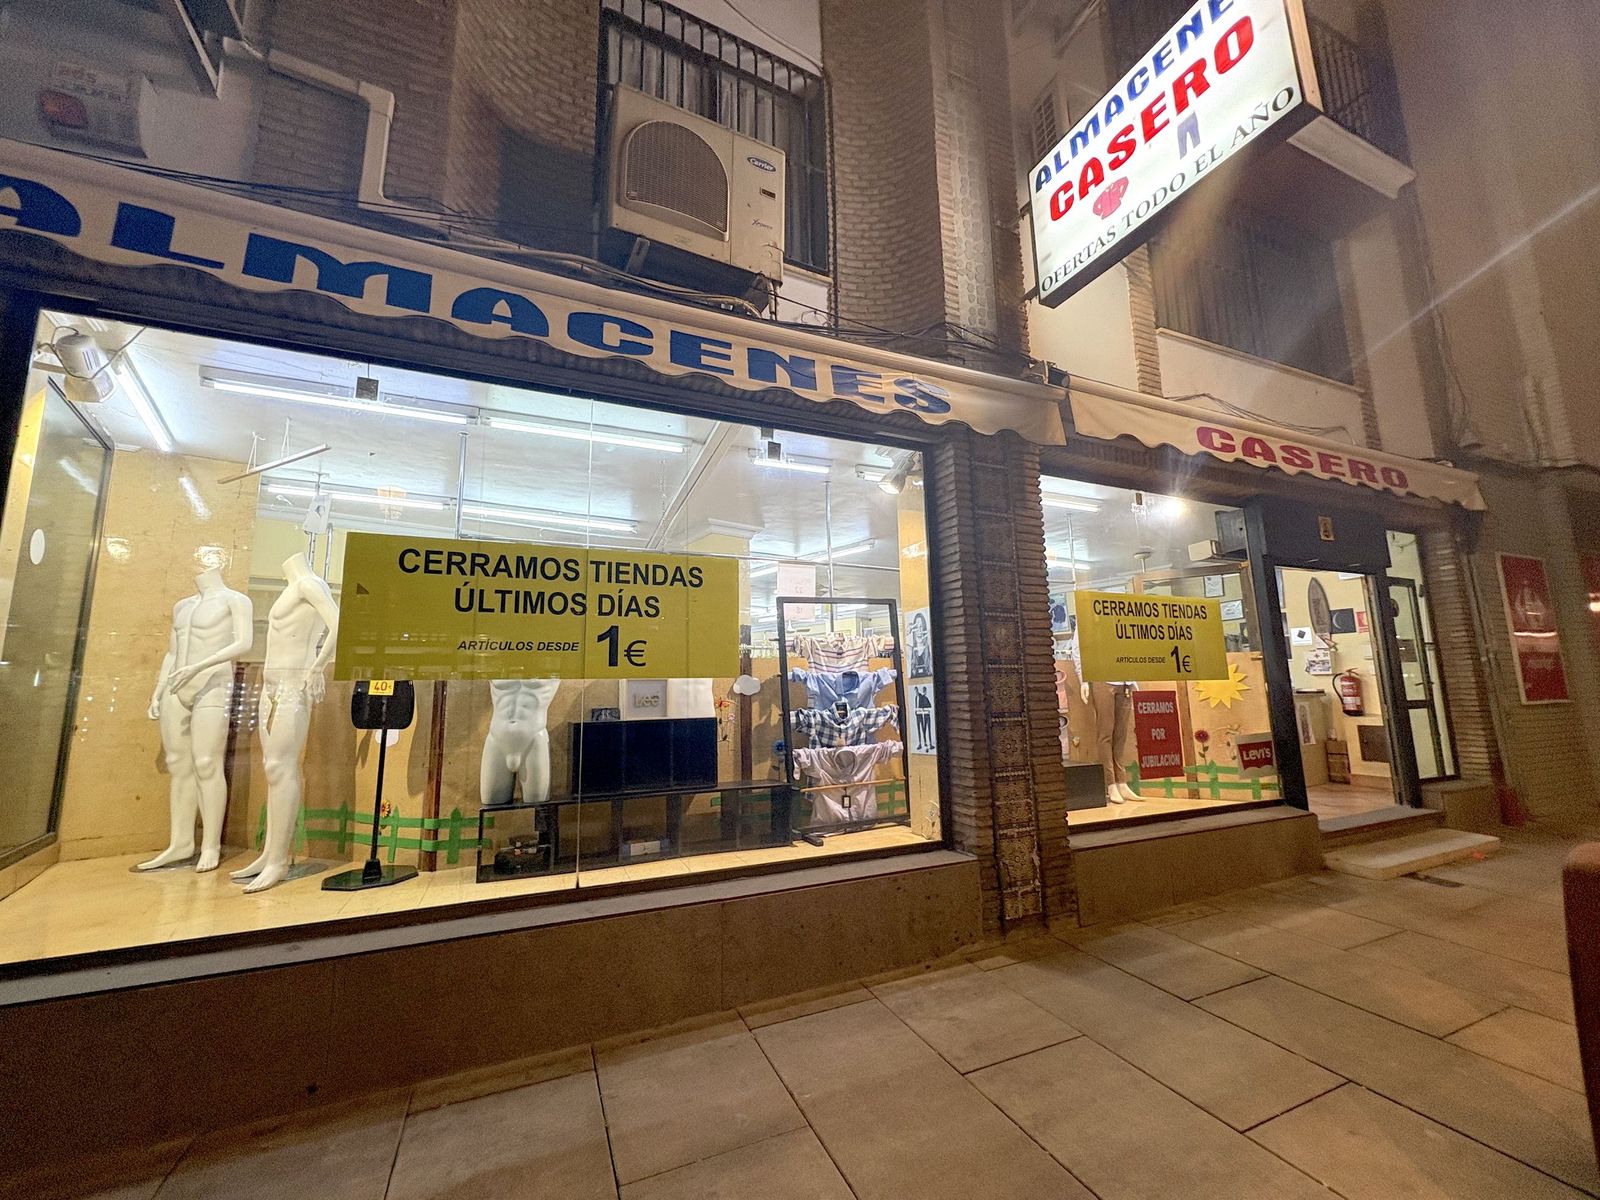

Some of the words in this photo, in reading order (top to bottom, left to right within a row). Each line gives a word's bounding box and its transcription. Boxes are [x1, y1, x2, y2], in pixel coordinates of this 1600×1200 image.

[1049, 16, 1254, 221] CASERO
[748, 158, 774, 171] Carrier
[1041, 226, 1116, 292] OFERTAS
[1122, 172, 1186, 231] TODO
[1194, 144, 1224, 175] EL
[1230, 86, 1295, 148] AÑO
[1196, 426, 1409, 489] CASERO
[398, 548, 580, 582] CERRAMOS
[589, 560, 703, 588] TIENDAS
[454, 581, 587, 616] ÚLTIMOS
[597, 589, 660, 618] DÍAS
[1093, 599, 1159, 618] CERRAMOS
[1161, 603, 1208, 620] TIENDAS
[1115, 619, 1165, 640] ÚLTIMOS
[1167, 621, 1193, 640] DÍAS
[457, 639, 534, 651] ARTÍCULOS
[537, 641, 580, 652] DESDE
[596, 625, 647, 667] 1€
[1148, 656, 1166, 664] DESDE
[1170, 645, 1192, 673] 1€
[1137, 702, 1175, 715] CERRAMOS
[1151, 727, 1167, 741] POR
[1140, 752, 1181, 769] JUBILACIÓN
